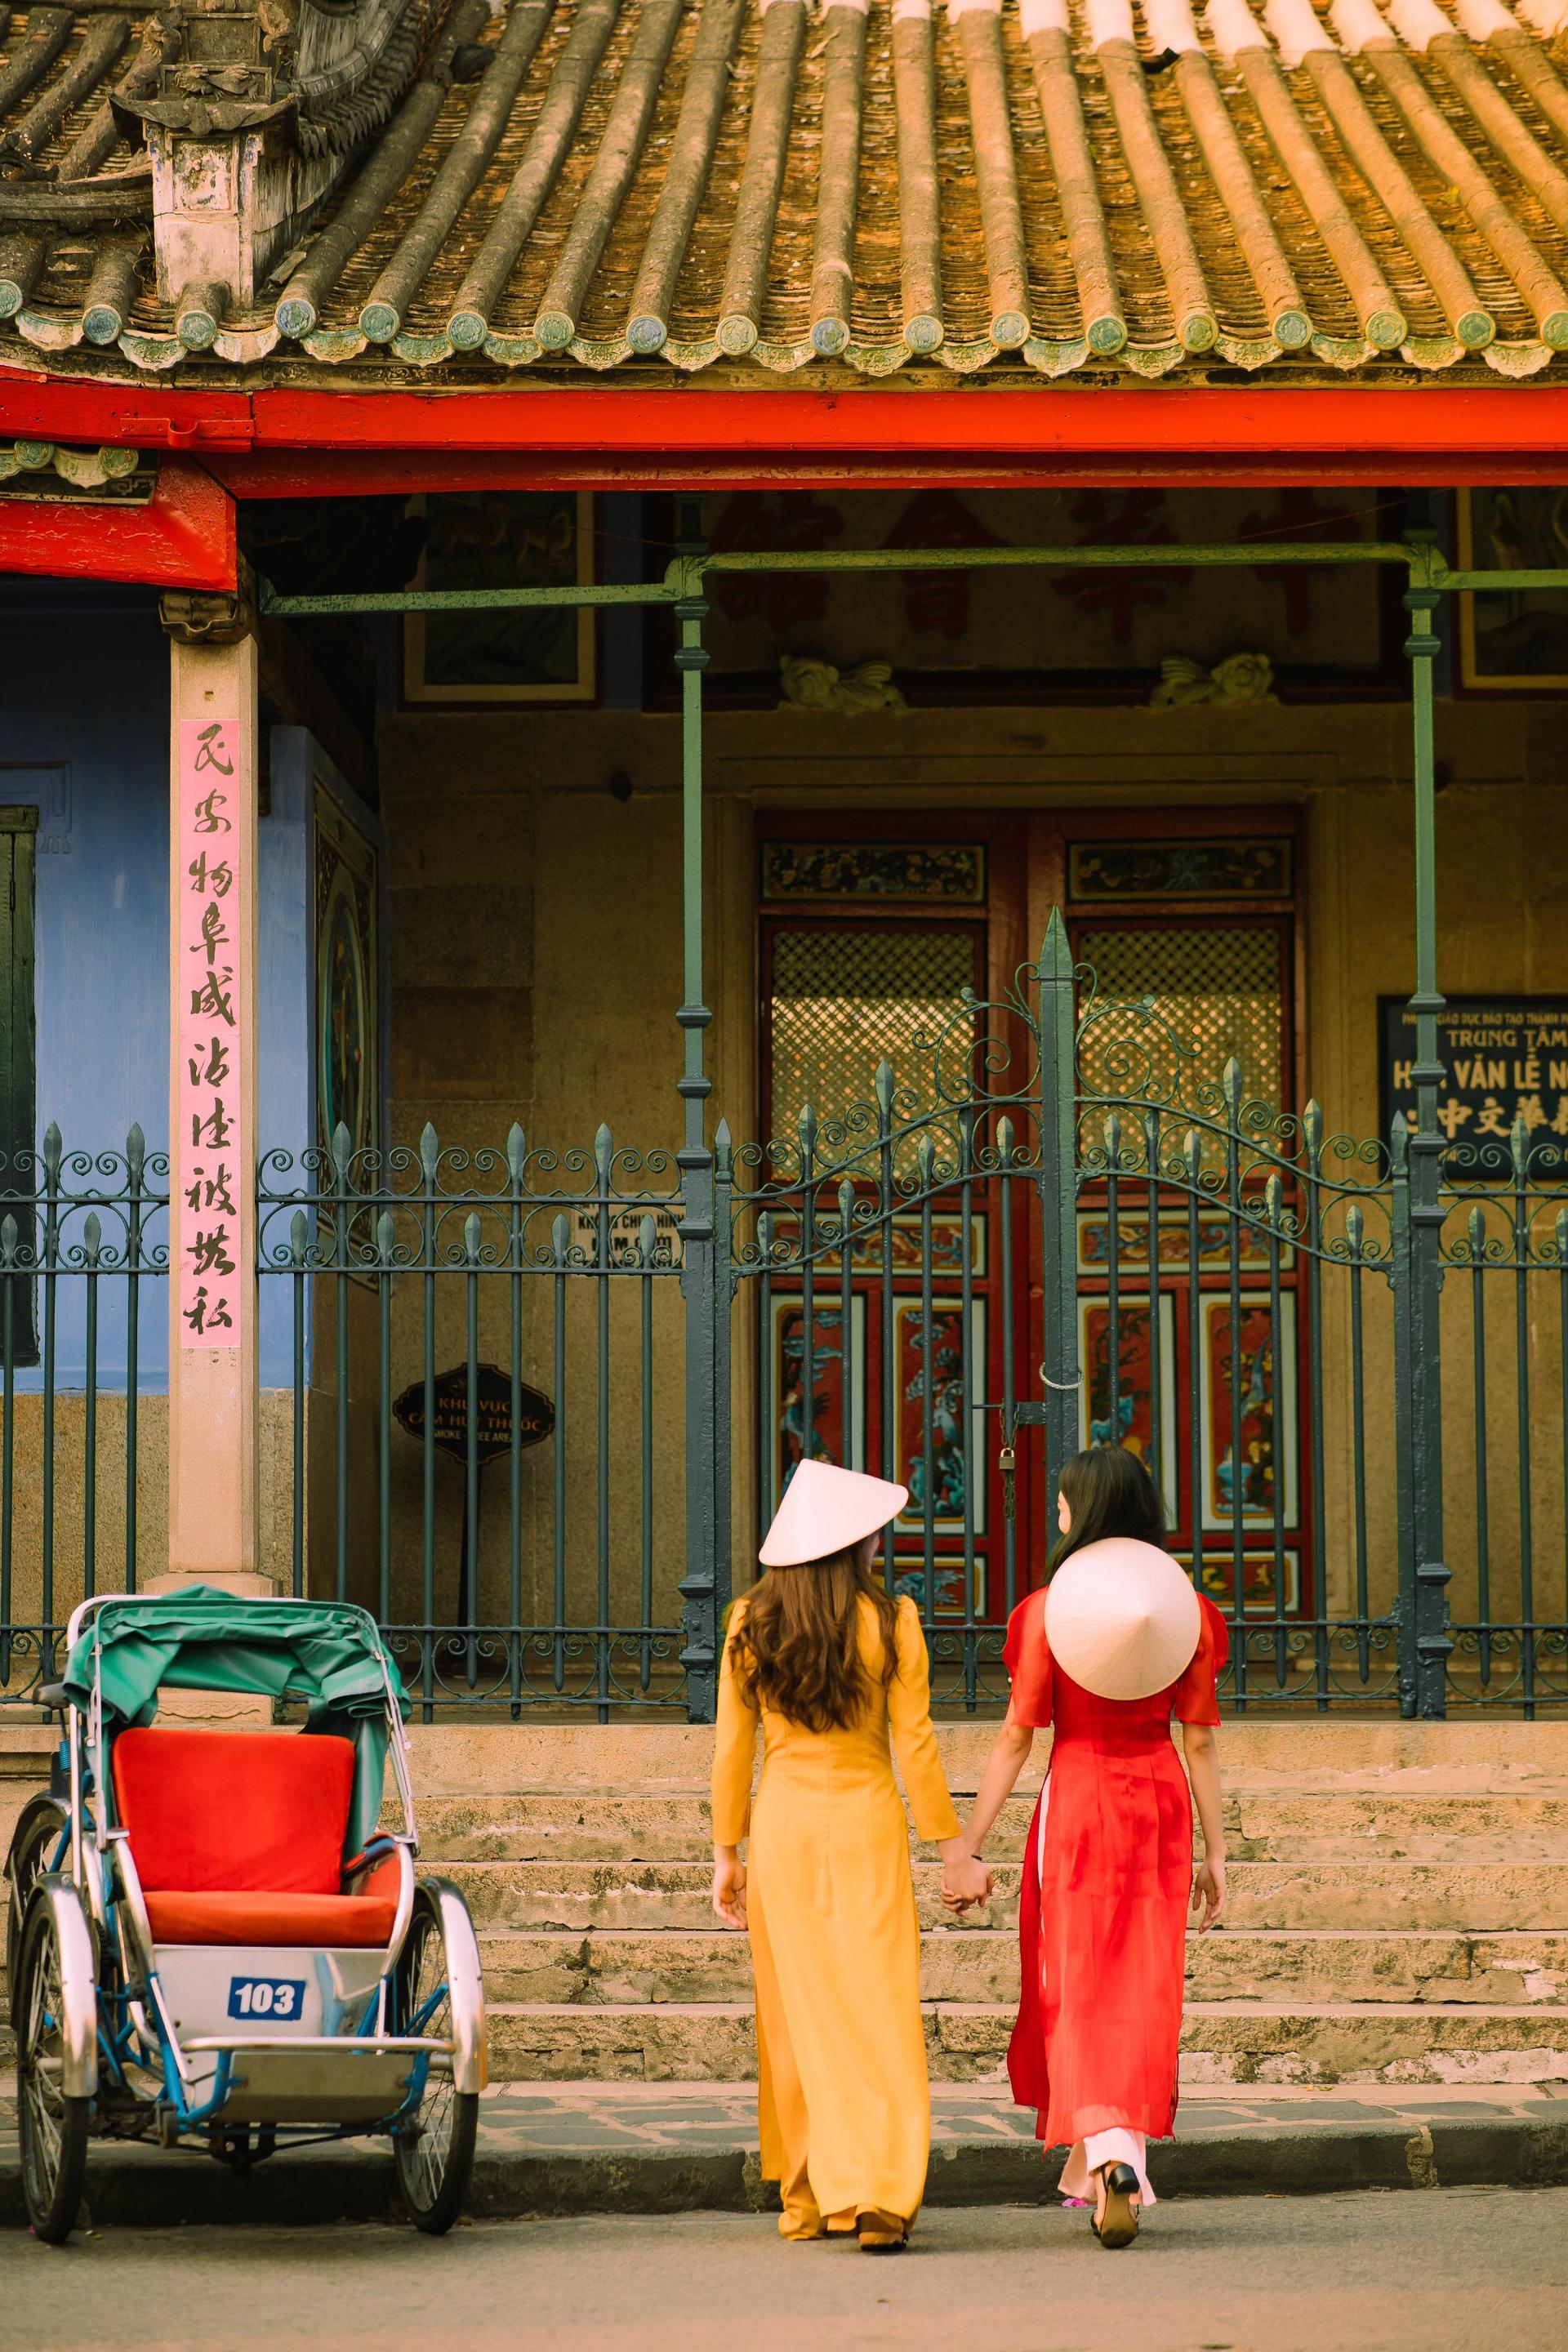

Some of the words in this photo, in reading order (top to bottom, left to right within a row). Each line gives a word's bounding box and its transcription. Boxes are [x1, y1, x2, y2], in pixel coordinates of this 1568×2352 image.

[1446, 1029, 1517, 1047] TRUNG
[1523, 1026, 1568, 1047] TÂM
[1454, 1054, 1506, 1089] VĂN
[235, 1983, 295, 2015] 103
